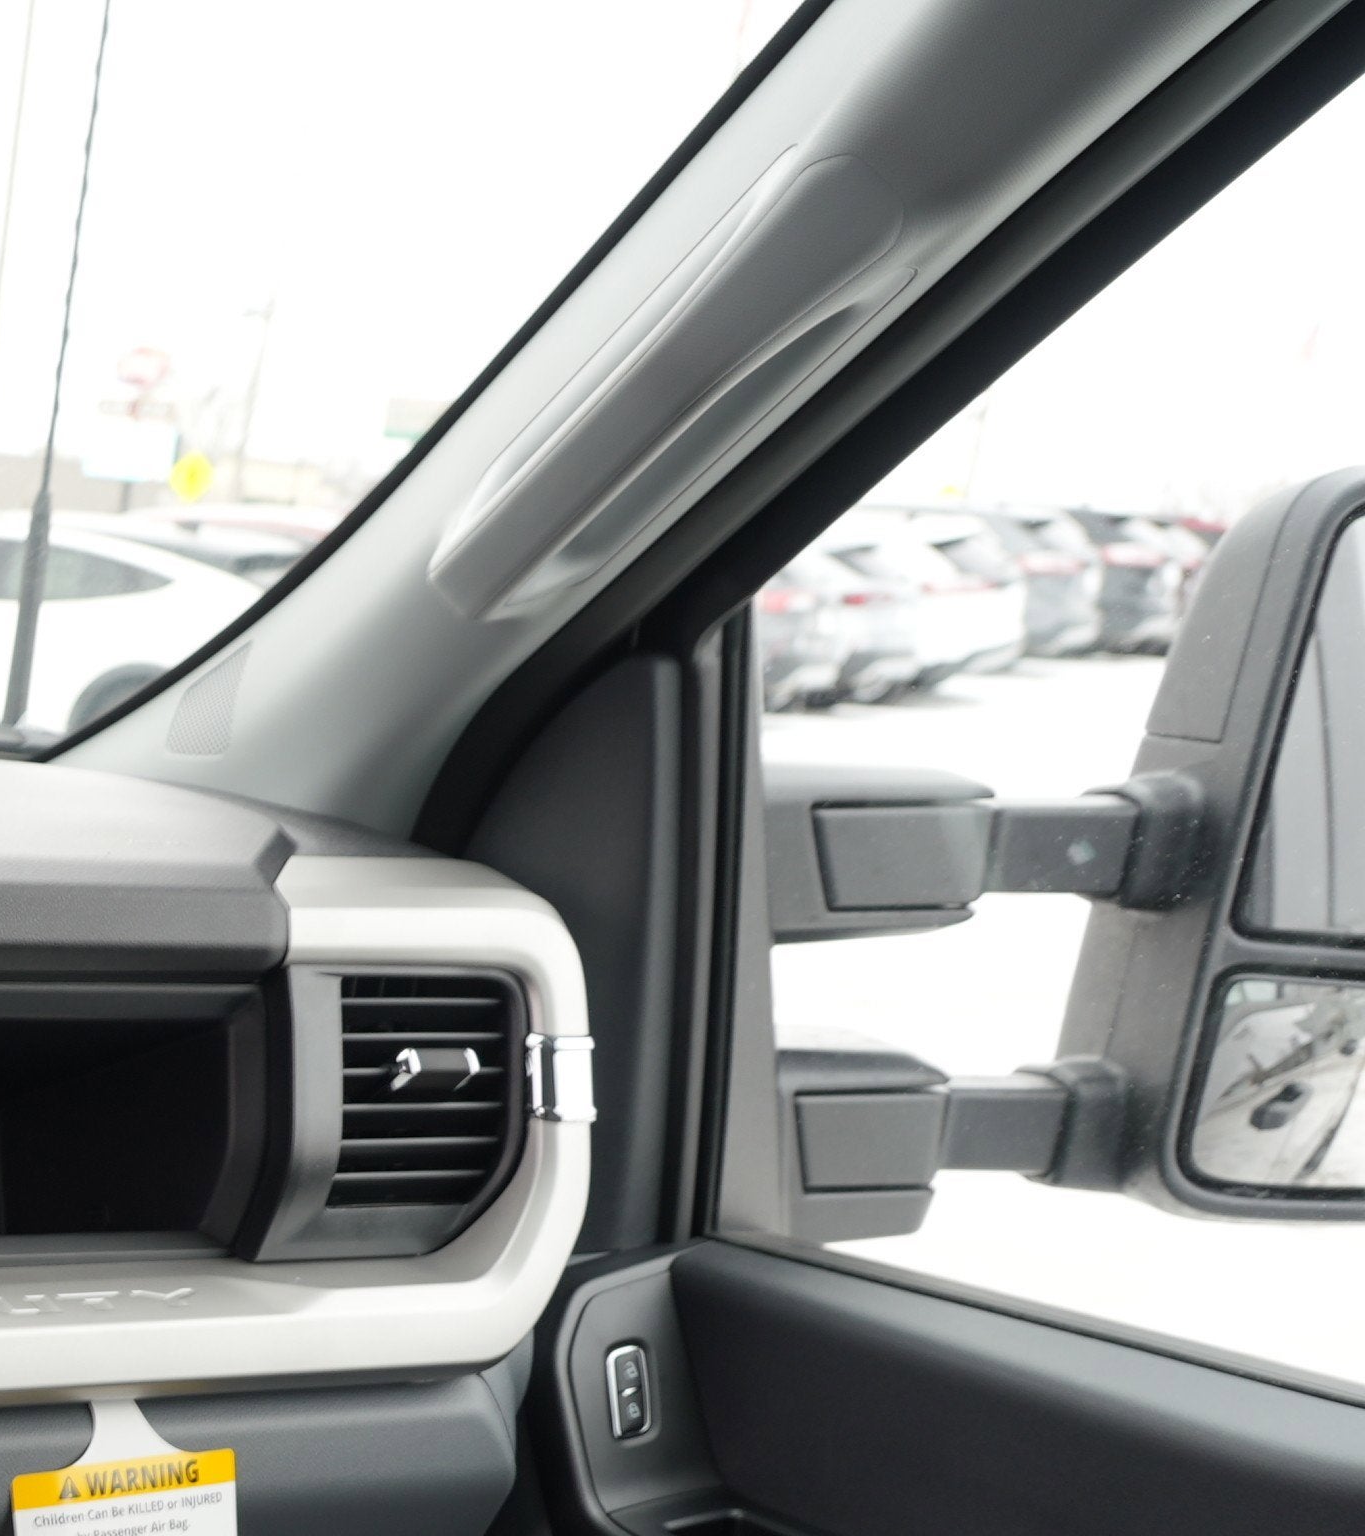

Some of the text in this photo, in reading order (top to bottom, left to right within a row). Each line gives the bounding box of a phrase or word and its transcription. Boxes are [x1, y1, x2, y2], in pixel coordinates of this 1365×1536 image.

[85, 1458, 200, 1497] WARNING
[34, 1491, 222, 1528] Children Can Be KILLED or INJURED
[150, 1521, 165, 1533] Air
[169, 1518, 191, 1532] Bag.
